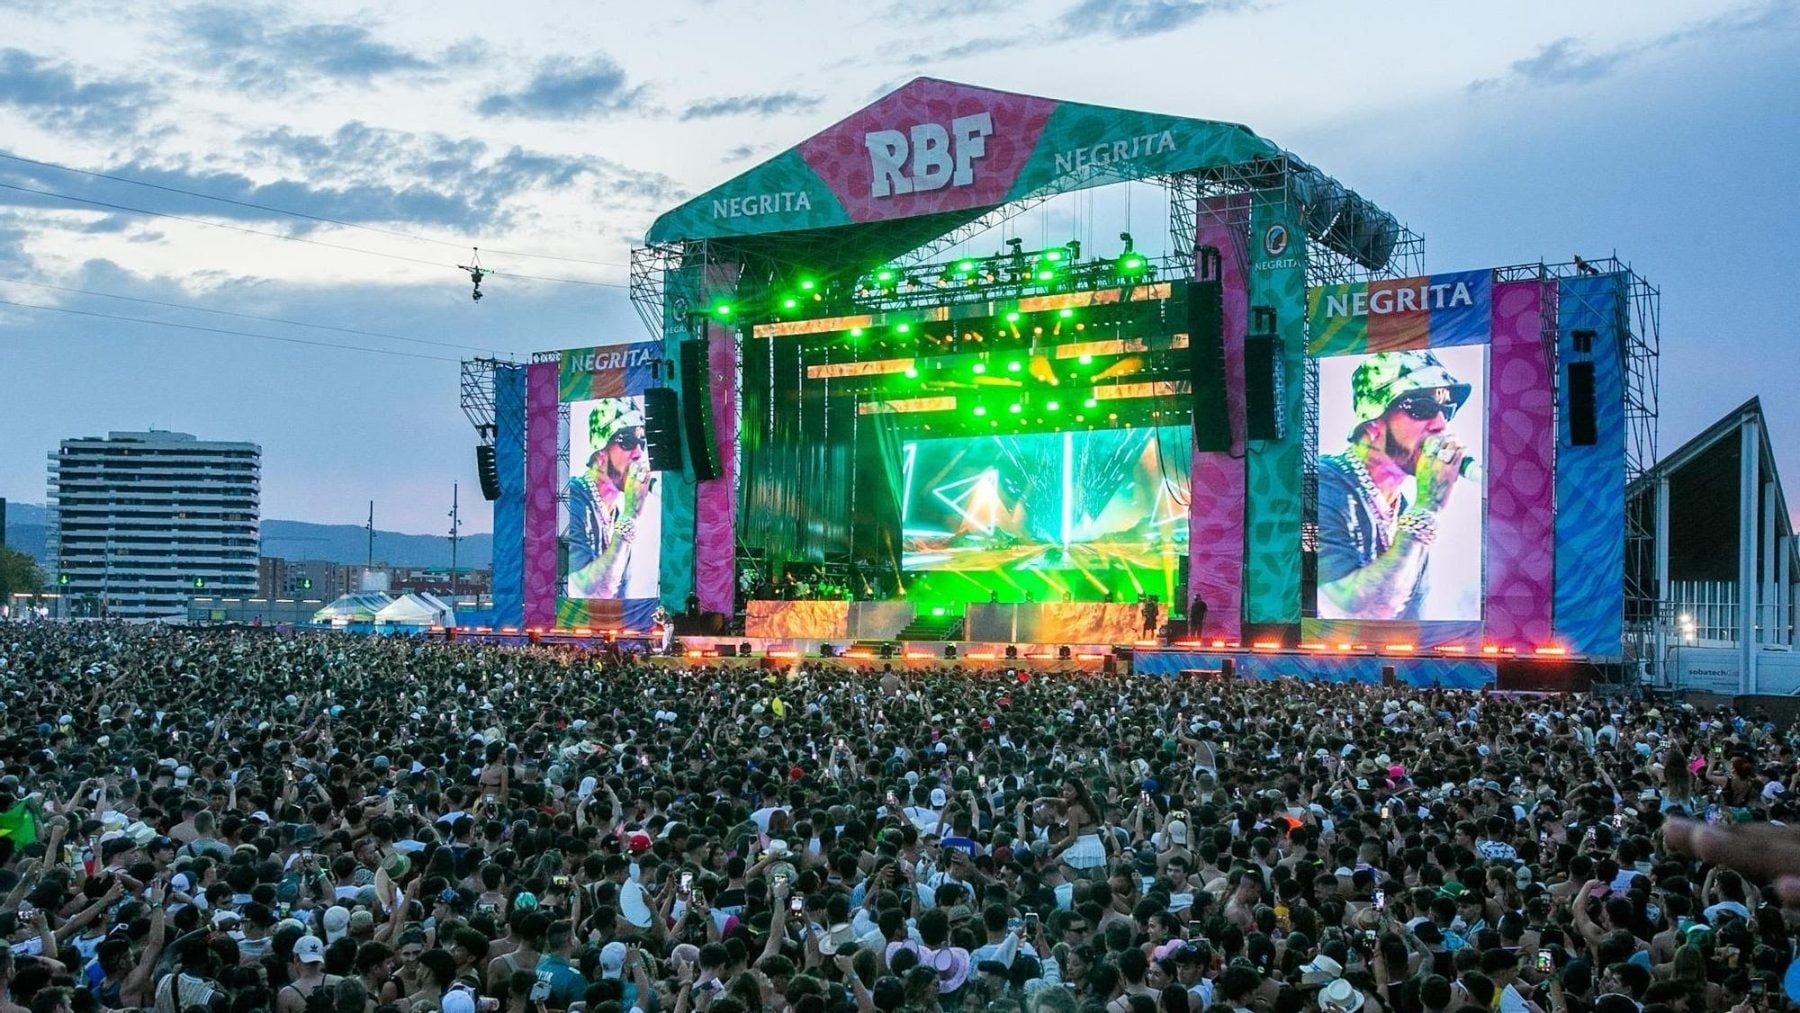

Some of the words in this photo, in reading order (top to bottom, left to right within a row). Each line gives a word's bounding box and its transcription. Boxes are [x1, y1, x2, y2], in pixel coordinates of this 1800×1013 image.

[865, 111, 993, 198] RBF
[1054, 130, 1177, 175] NEGRITA
[712, 191, 812, 219] NEGRITA
[1255, 258, 1301, 271] NEGRITA
[1326, 282, 1473, 318] NEGRITA
[571, 348, 653, 373] NEGRITA
